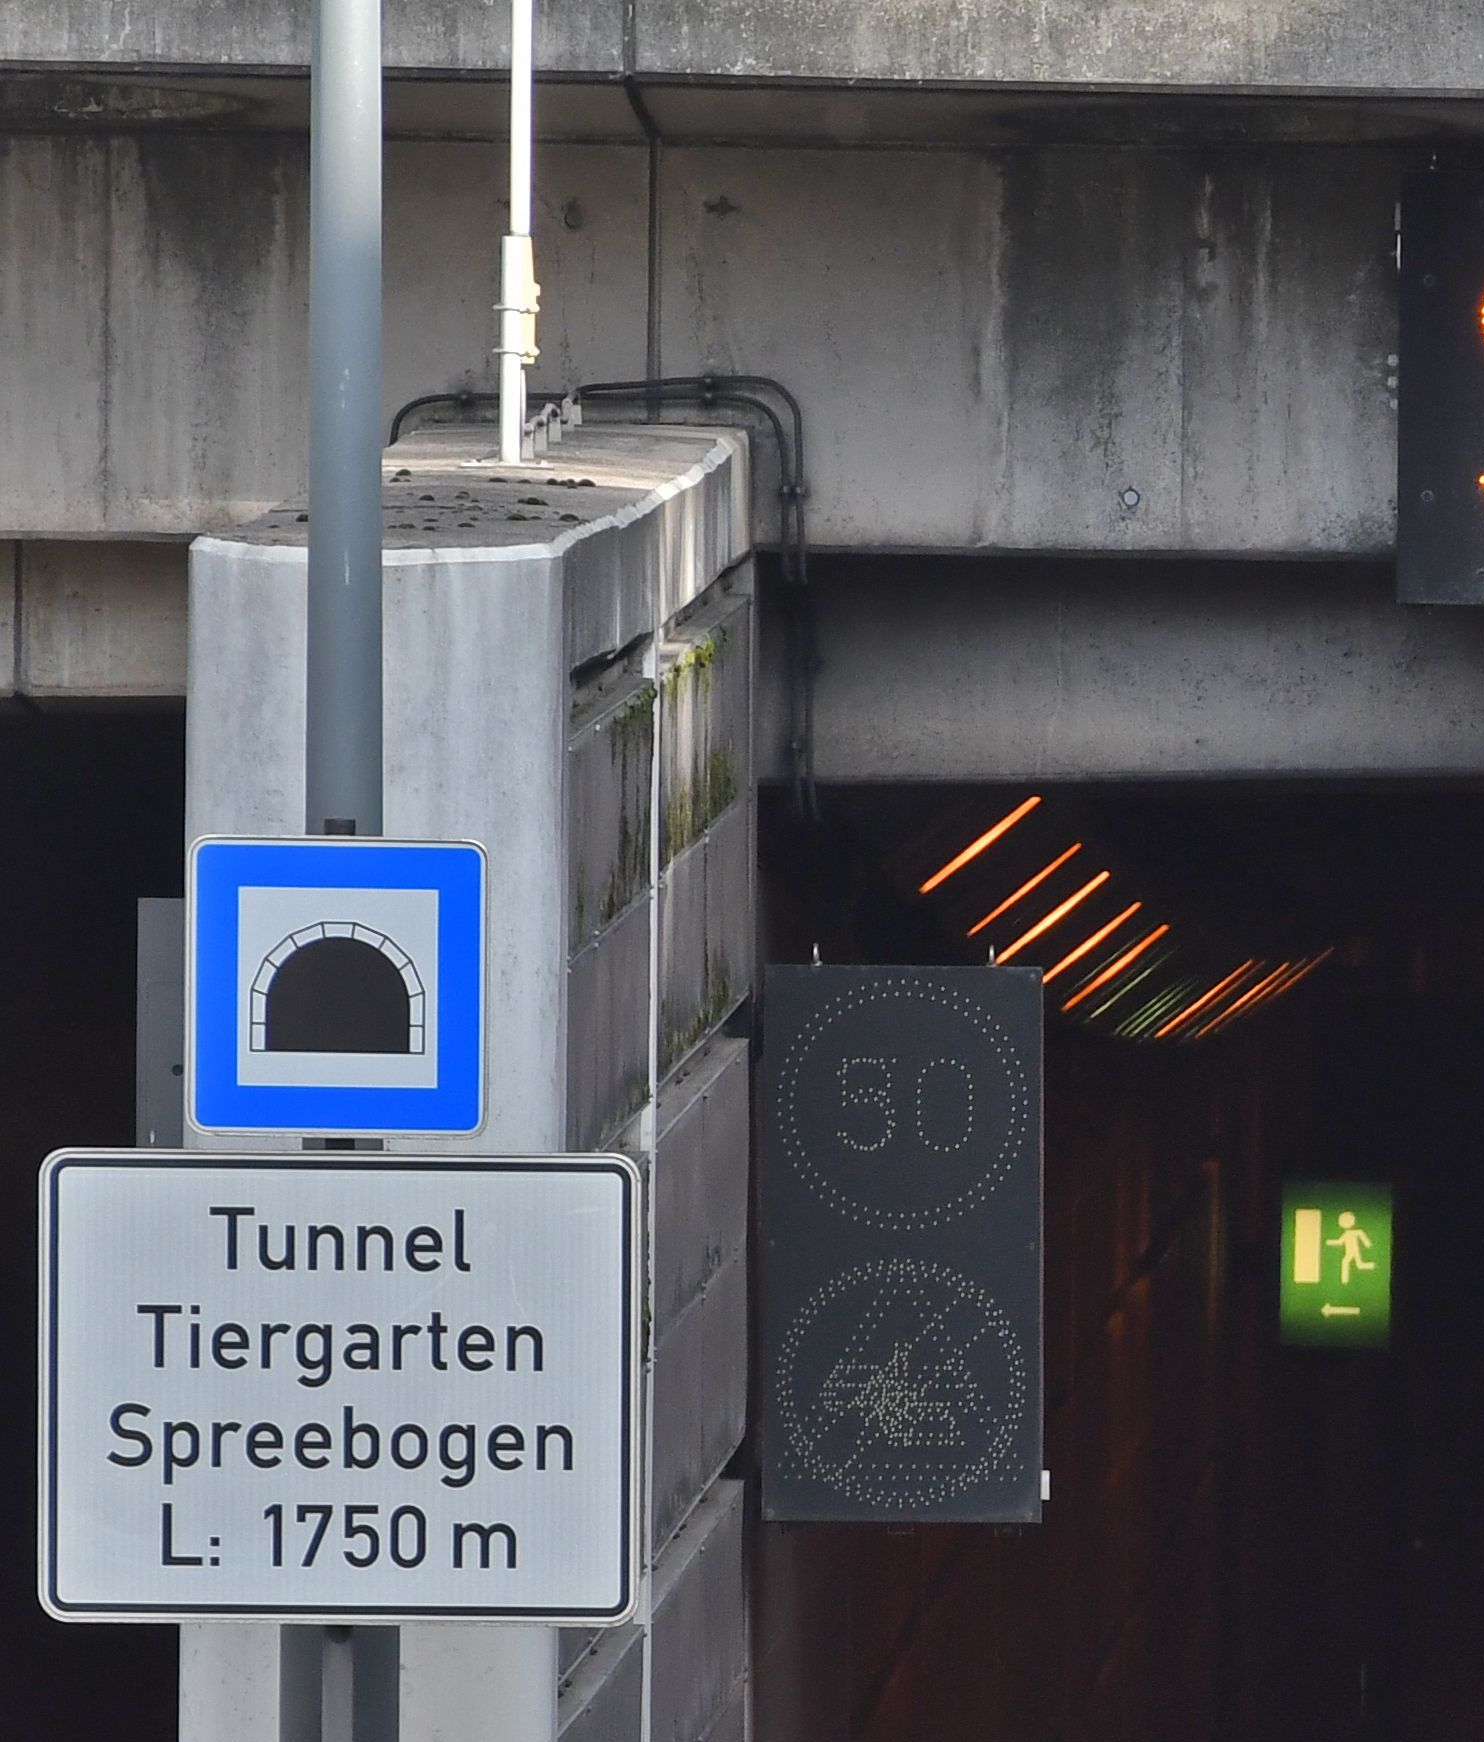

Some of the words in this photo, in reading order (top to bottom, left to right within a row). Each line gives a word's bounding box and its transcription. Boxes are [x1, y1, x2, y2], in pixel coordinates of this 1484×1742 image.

[209, 1206, 471, 1272] Tunnel
[137, 1304, 544, 1387] Tiergarten
[107, 1403, 573, 1487] Spreebogen
[161, 1502, 220, 1567] L:
[263, 1504, 427, 1569] 1750
[453, 1522, 517, 1569] m
